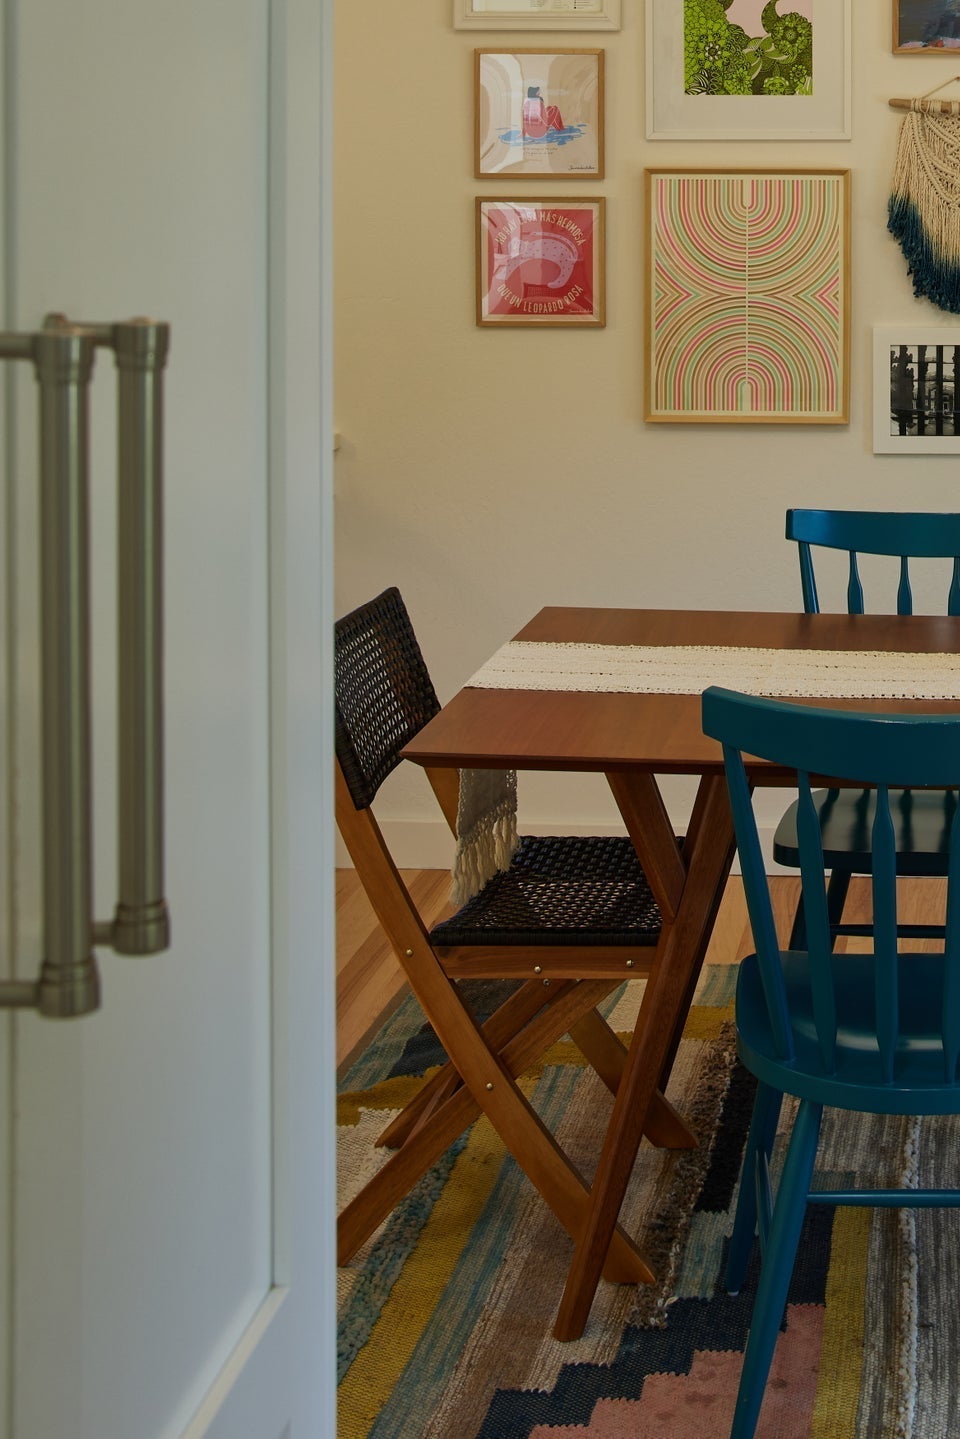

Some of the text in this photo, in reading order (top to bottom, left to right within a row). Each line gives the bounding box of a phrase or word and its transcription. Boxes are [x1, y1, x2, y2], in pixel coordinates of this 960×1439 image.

[556, 215, 587, 246] HERMOSA
[496, 283, 584, 313] QUE UN LEOPARDO ROSA
